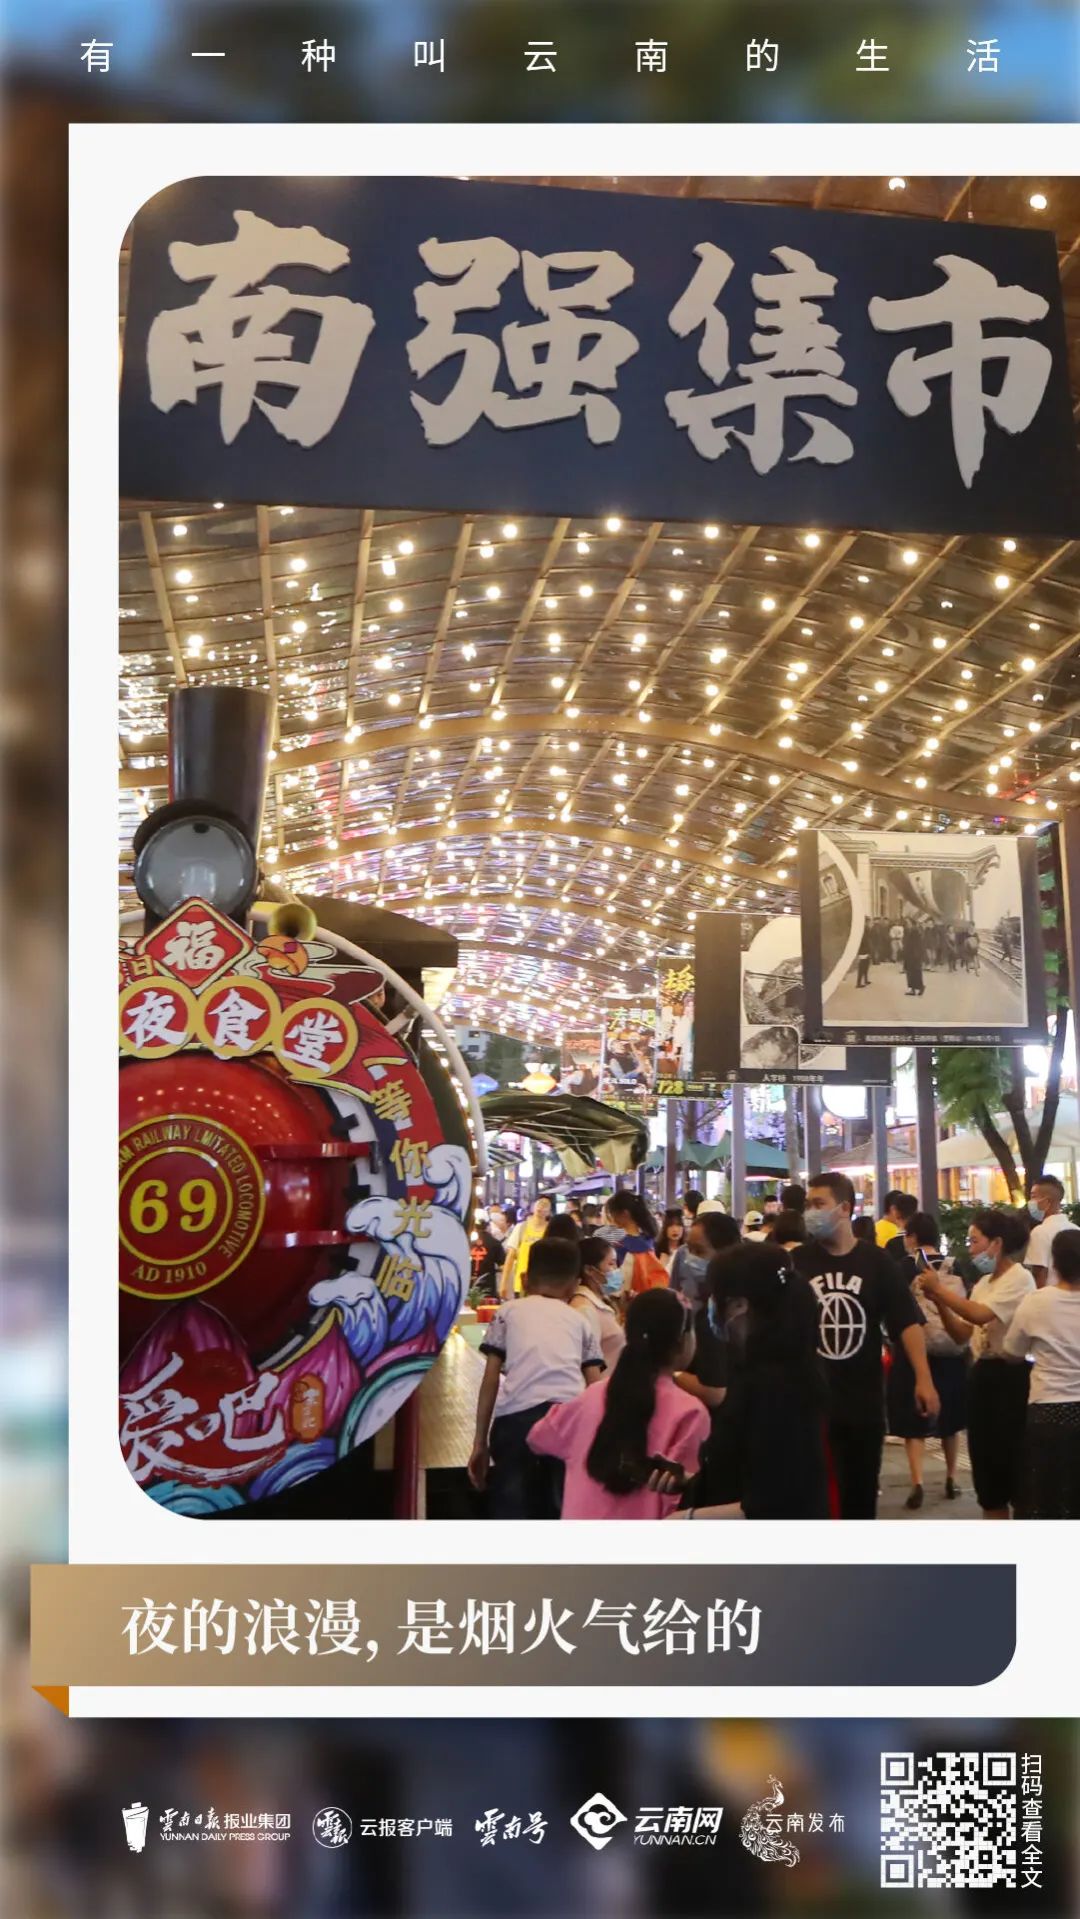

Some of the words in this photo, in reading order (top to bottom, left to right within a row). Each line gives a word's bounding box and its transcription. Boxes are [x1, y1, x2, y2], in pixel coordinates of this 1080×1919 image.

[146, 209, 1054, 489] 南强集市
[163, 920, 226, 971] 福
[123, 989, 344, 1074] 夜食堂
[129, 1178, 218, 1234] 69
[134, 1125, 193, 1151] RAILWAY
[217, 1173, 255, 1259] LOCOMOTIVE
[369, 1078, 433, 1303] 等你光临
[132, 1263, 160, 1283] AD
[164, 1260, 207, 1284] 1910
[808, 1272, 864, 1300] FILA
